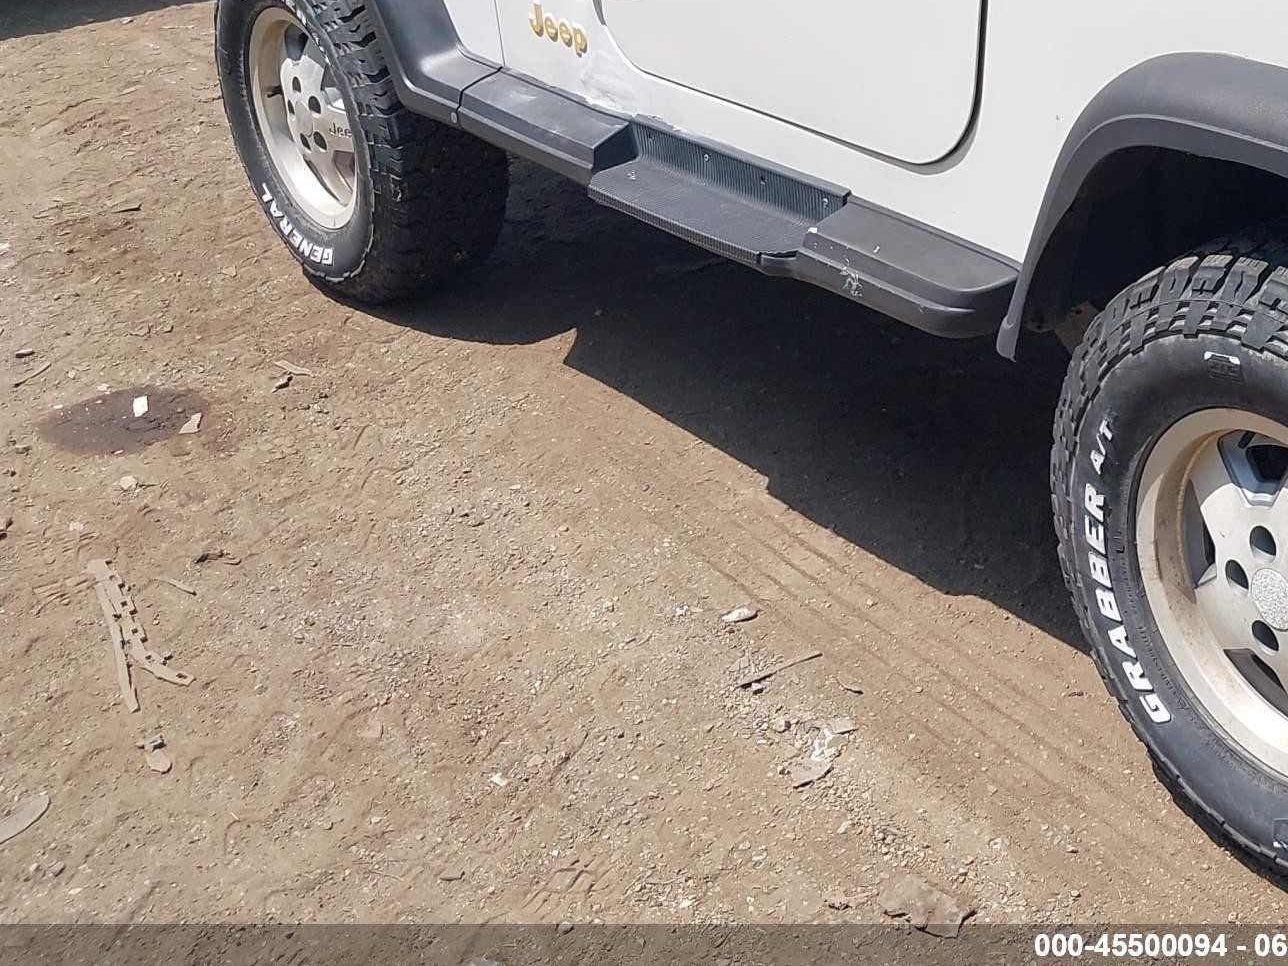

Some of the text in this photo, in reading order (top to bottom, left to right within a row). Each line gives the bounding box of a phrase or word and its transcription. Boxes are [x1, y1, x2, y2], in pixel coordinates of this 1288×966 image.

[529, 3, 588, 58] Jeep
[329, 122, 352, 138] Jee
[262, 182, 333, 265] GENERAL
[1085, 483, 1172, 724] GRABBER
